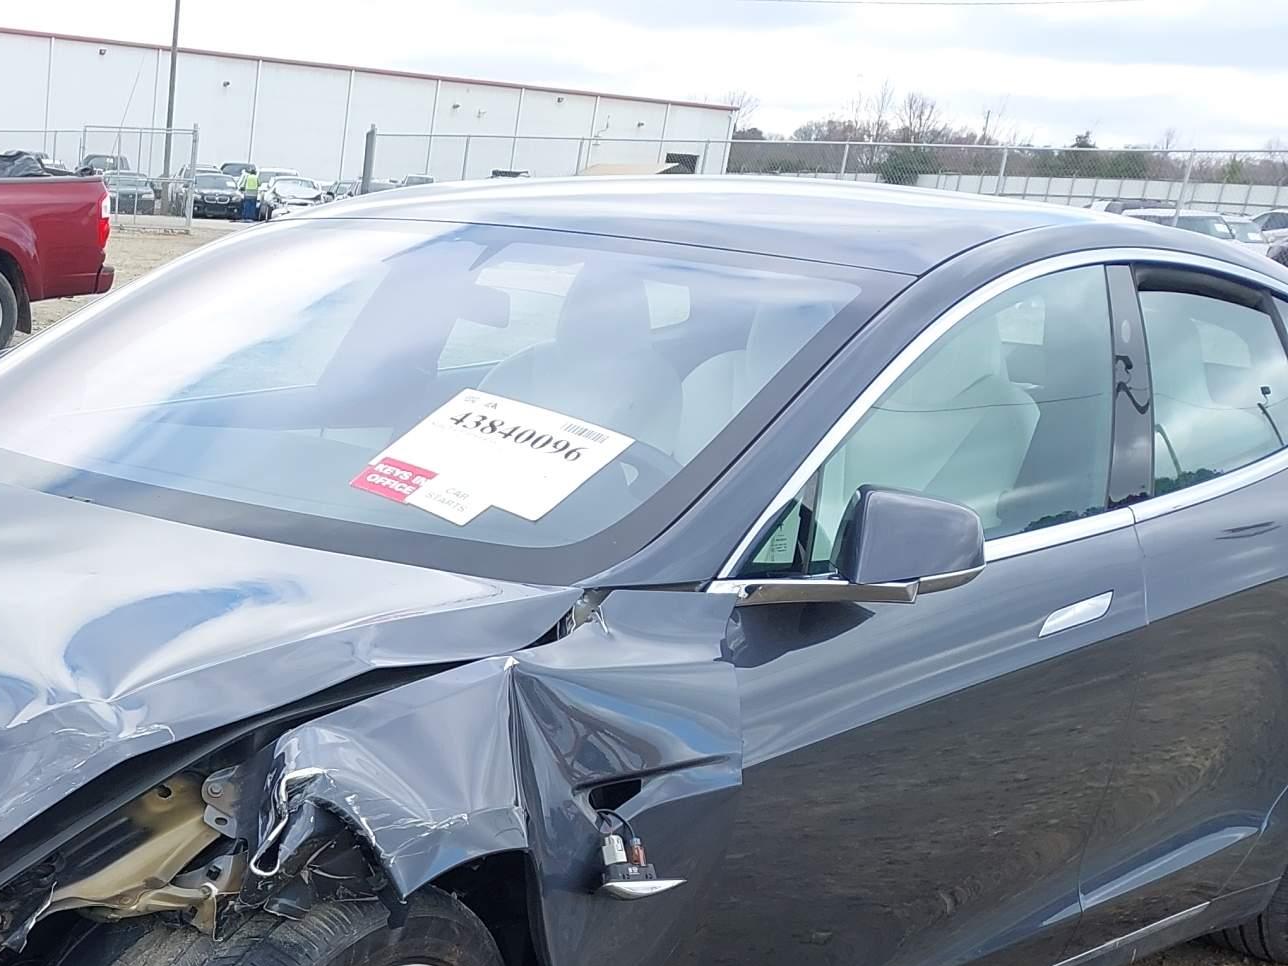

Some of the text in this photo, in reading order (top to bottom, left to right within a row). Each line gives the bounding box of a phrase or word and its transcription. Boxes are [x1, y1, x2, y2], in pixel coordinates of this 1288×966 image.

[449, 412, 590, 462] 43840096
[374, 463, 413, 480] KEYS
[367, 473, 416, 495] OFFICE
